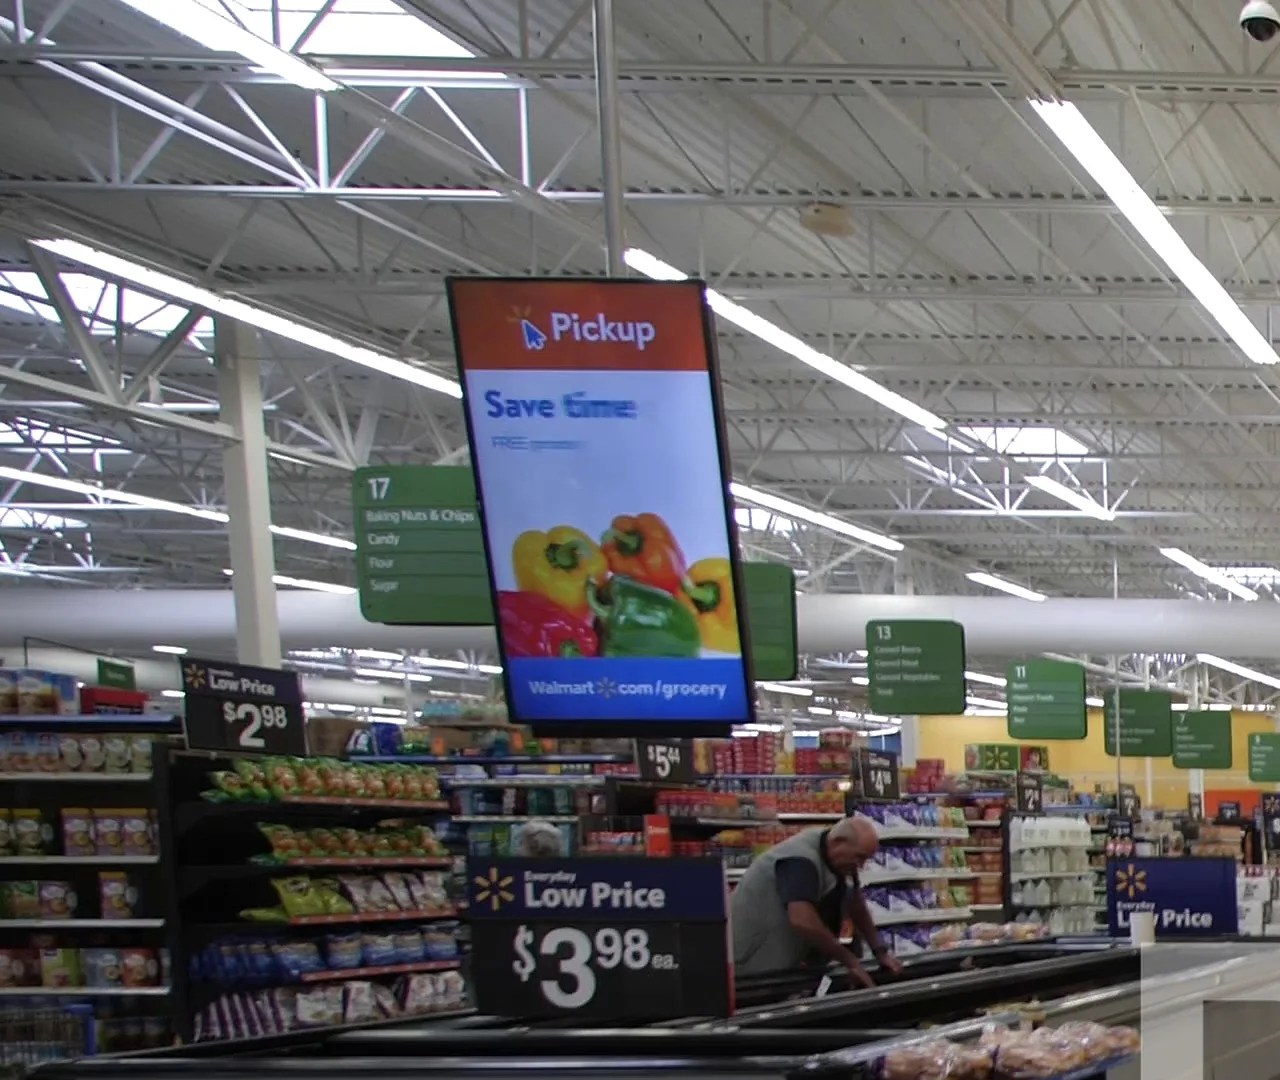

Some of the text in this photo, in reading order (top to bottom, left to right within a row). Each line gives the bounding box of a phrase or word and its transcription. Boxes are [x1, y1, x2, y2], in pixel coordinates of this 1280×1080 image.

[550, 312, 656, 350] Pickup
[484, 390, 554, 418] Save
[368, 477, 390, 500] 17
[366, 509, 475, 524] Baking Nuts & Chips
[367, 533, 401, 546] Candy
[368, 557, 394, 569] Flour
[876, 625, 892, 640] 13
[209, 675, 275, 696] Low Price
[528, 680, 595, 695] Walmart
[524, 870, 577, 883] Everyday
[524, 881, 665, 908] Low Price
[1116, 900, 1156, 912] Everyday
[1162, 908, 1213, 928] Price
